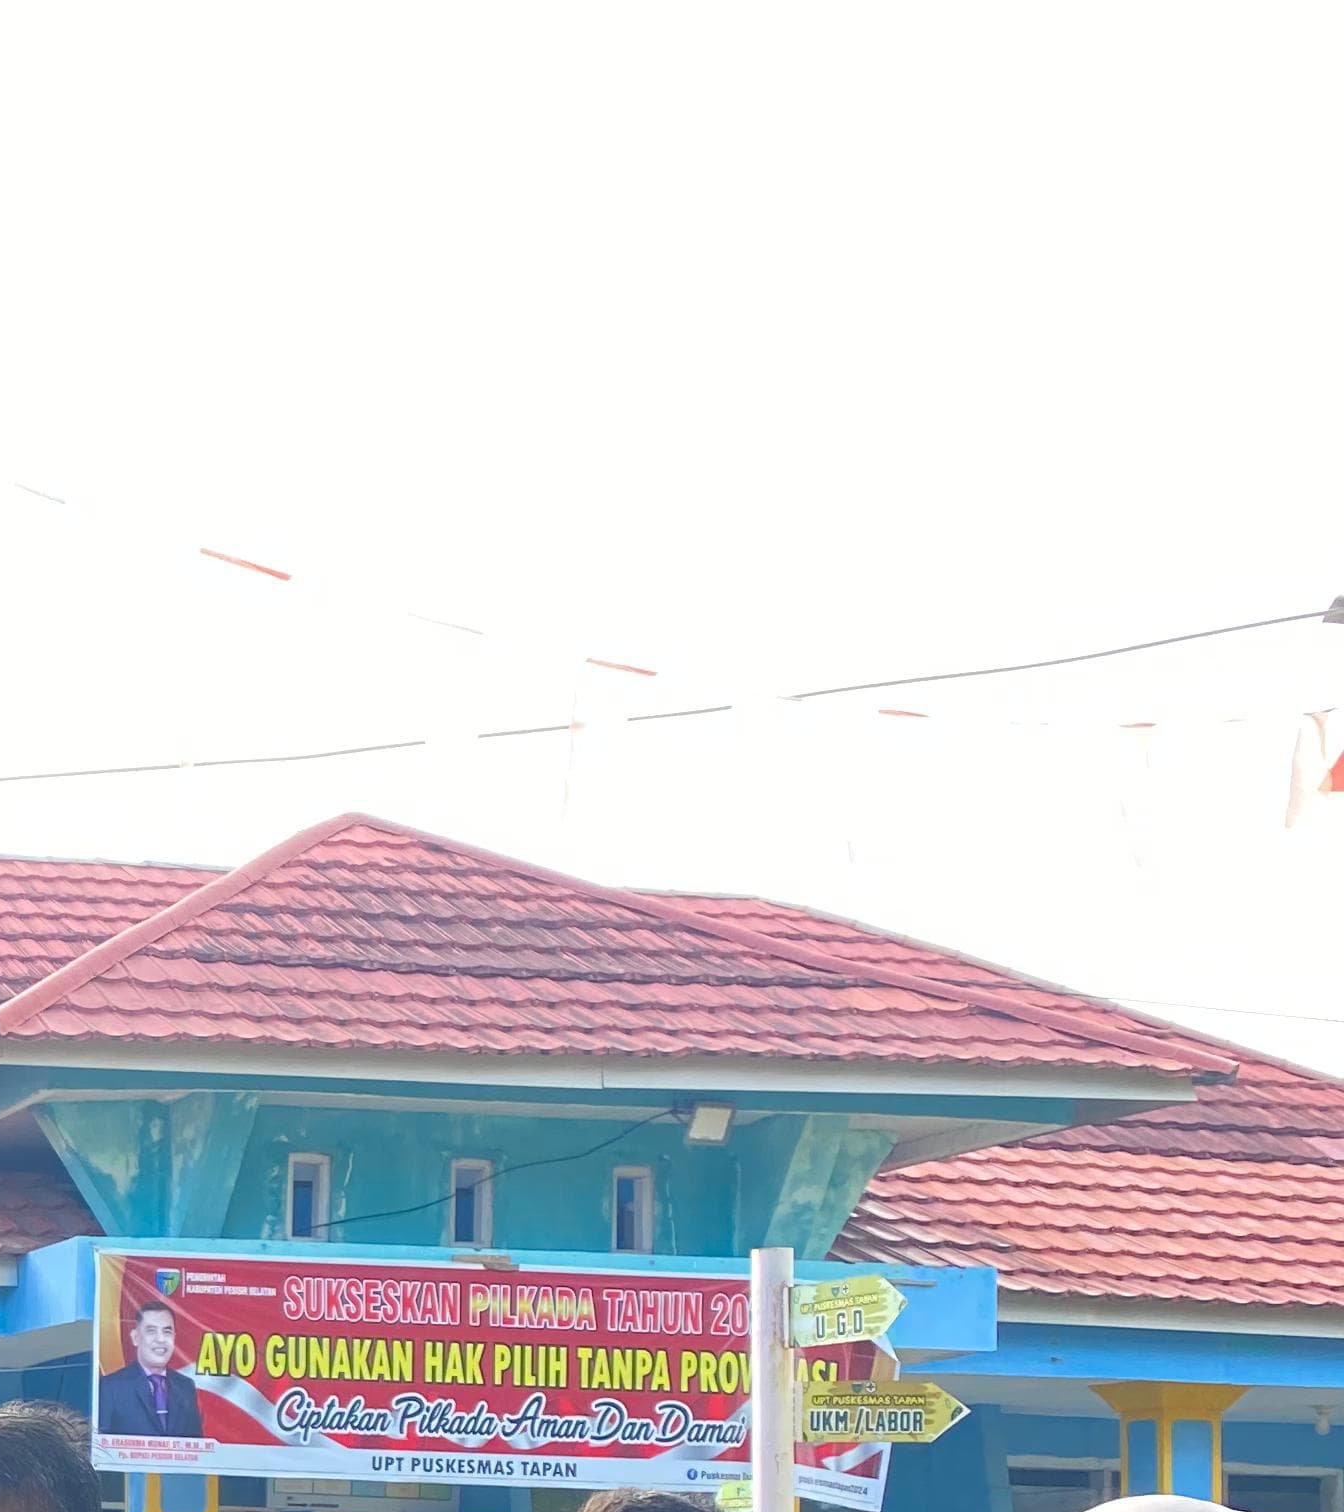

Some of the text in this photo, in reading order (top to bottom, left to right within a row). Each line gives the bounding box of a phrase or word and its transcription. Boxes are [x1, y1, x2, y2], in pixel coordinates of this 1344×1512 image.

[283, 1275, 461, 1326] SUKSESKAN
[468, 1283, 597, 1332] PILKADA
[603, 1288, 704, 1335] TAHUN
[814, 1297, 854, 1313] PUSKESMAS
[196, 1332, 257, 1378] AYO
[265, 1334, 414, 1382] GUNAKAN
[424, 1340, 486, 1386] HAK
[494, 1343, 568, 1388] PILIH
[576, 1347, 671, 1392] TANPA
[833, 1395, 892, 1406] PUSKESMAS
[893, 1395, 925, 1405] TAPAN
[277, 1388, 747, 1446] Ciptakan Pilkada Aman Dan Damai
[809, 1408, 924, 1434] UKM /LABOR
[371, 1456, 578, 1478] UPT PUSKESMAS TAPAN
